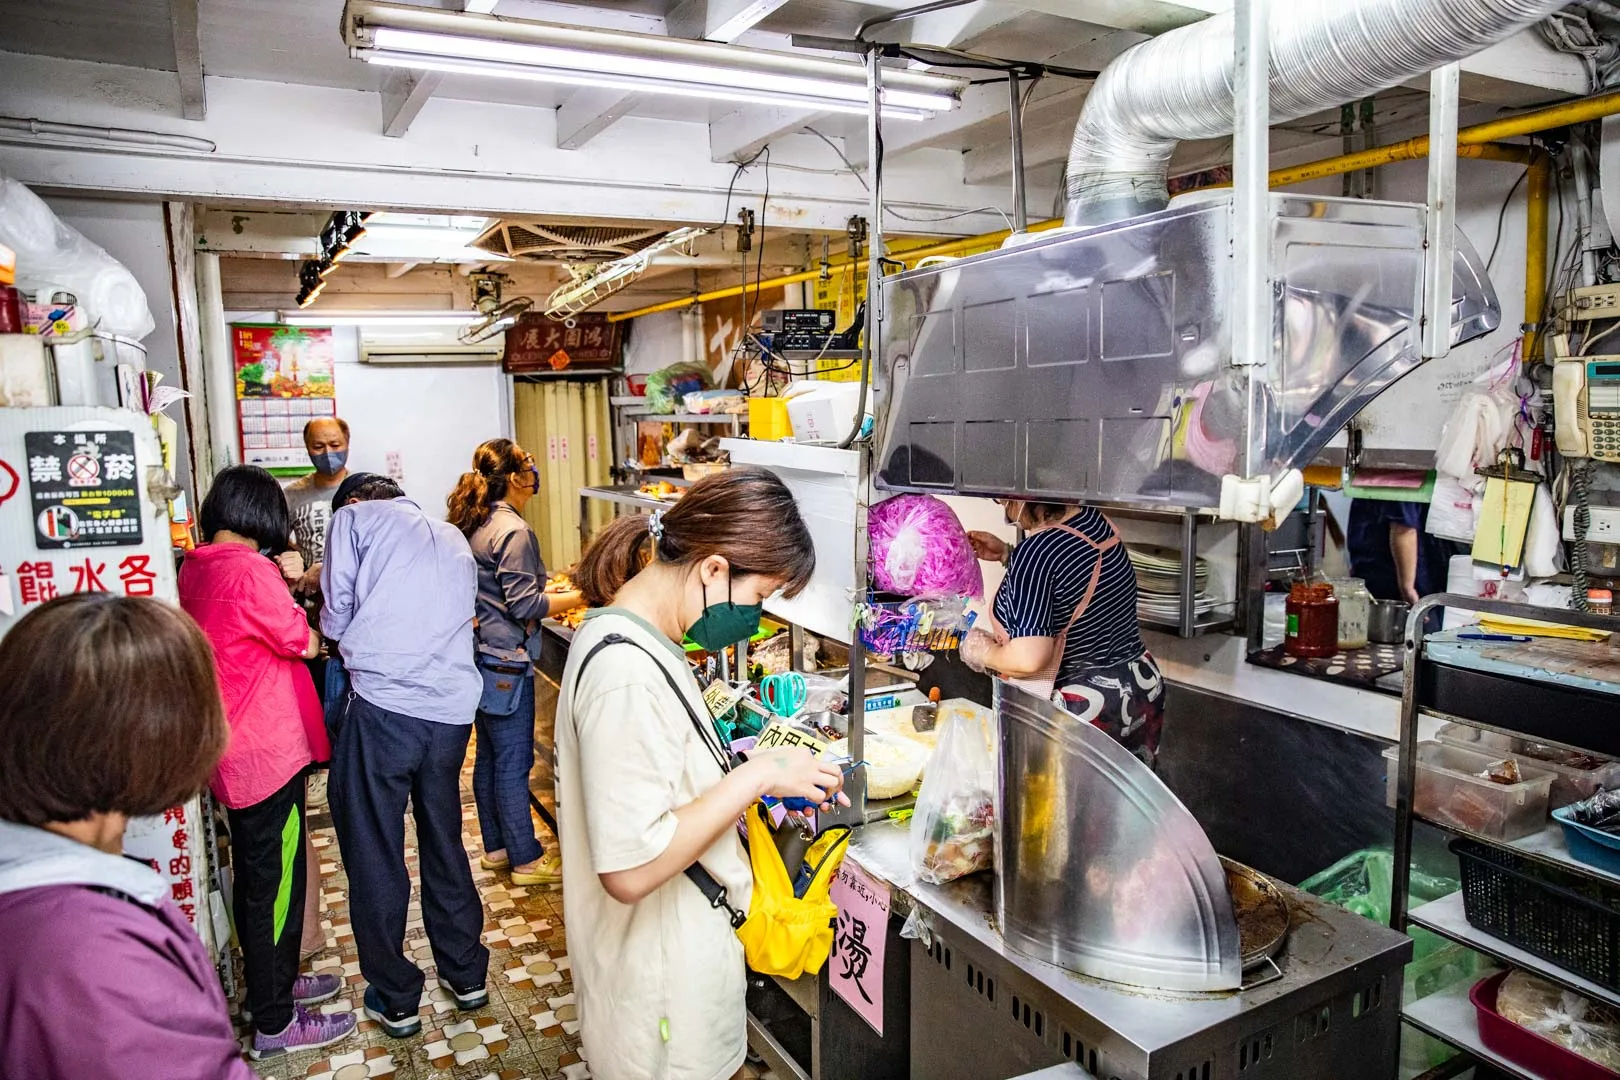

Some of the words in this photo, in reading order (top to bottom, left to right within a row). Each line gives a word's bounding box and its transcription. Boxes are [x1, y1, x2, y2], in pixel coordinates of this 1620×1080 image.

[836, 868, 887, 912] 勿靠近,小心
[830, 908, 873, 1005] 燙
